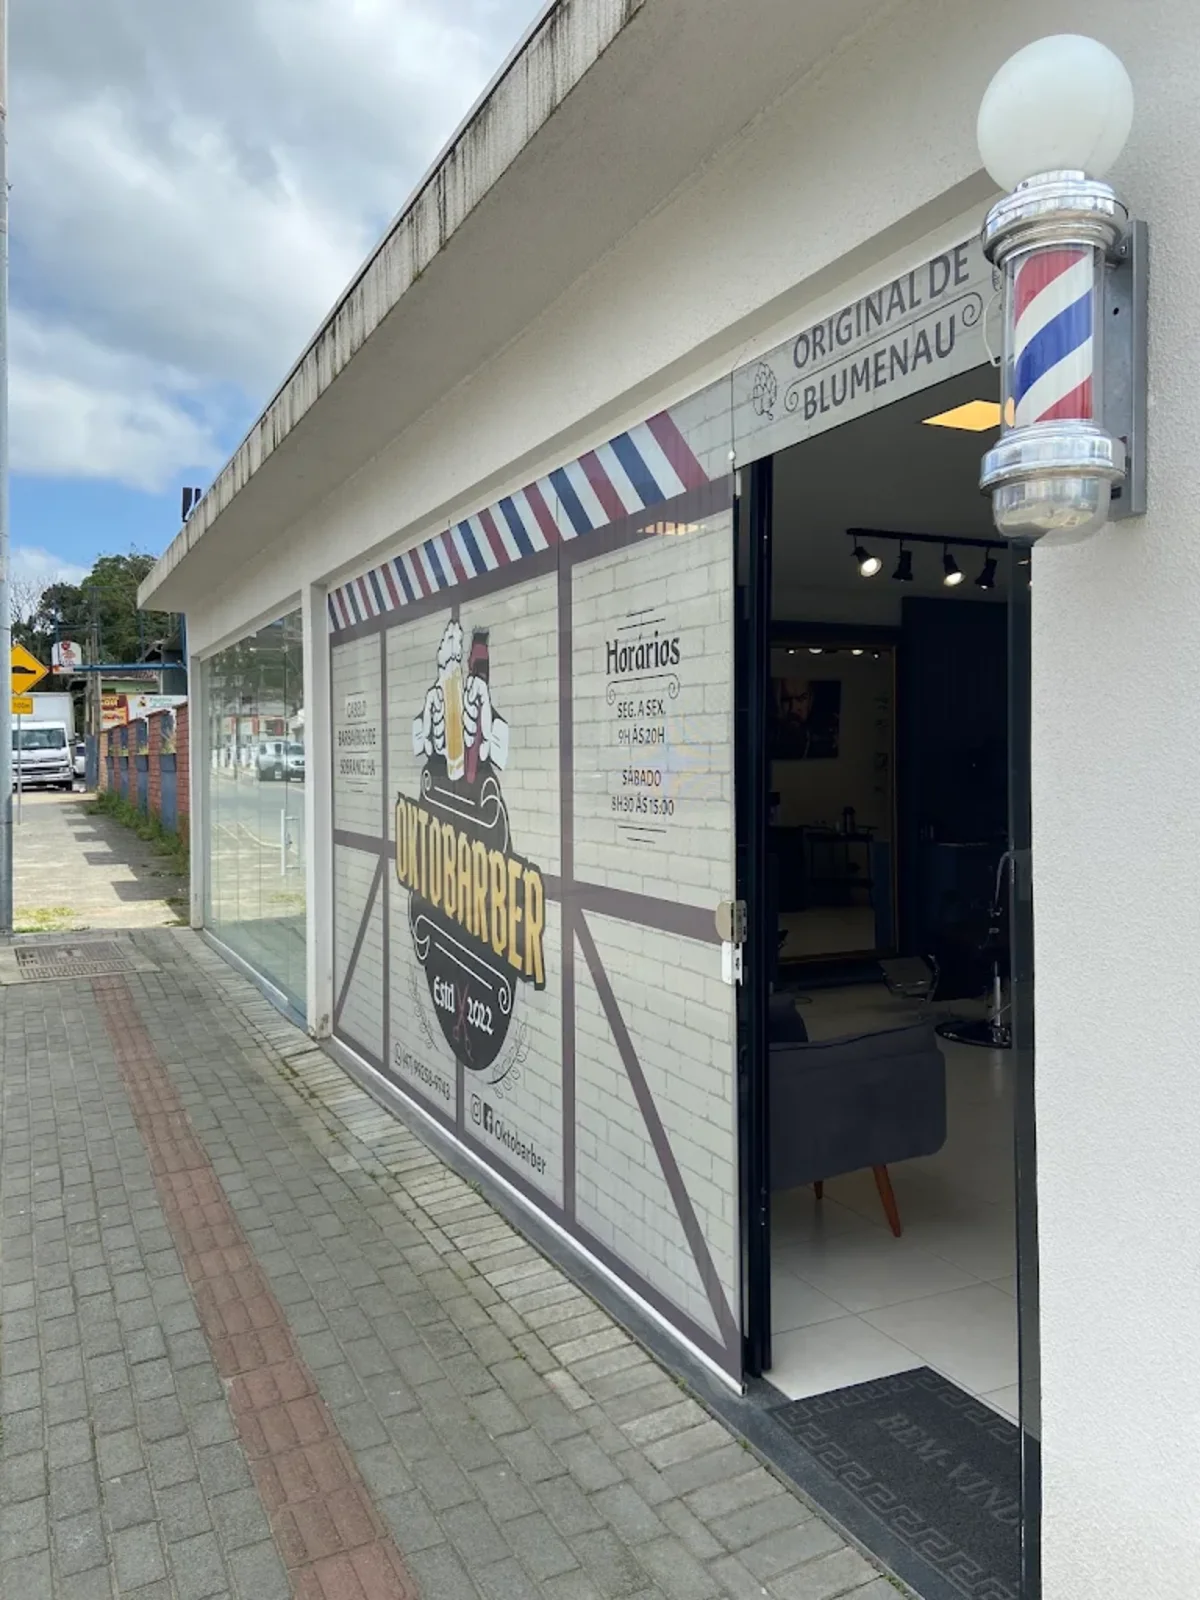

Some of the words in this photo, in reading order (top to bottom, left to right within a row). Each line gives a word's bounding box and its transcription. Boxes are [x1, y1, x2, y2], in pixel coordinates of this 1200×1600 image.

[793, 269, 921, 369] ORIGINAL
[929, 242, 970, 298] DE
[803, 314, 956, 421] BLUMENAU
[606, 630, 680, 675] Horários
[617, 700, 637, 718] SEG.
[638, 700, 645, 717] A
[646, 698, 666, 716] SEX.
[618, 728, 631, 744] 9H
[645, 725, 665, 744] 20H
[622, 765, 662, 787] SÁBADO
[395, 797, 544, 985] OKTOBARBER
[467, 996, 494, 1036] 2022
[494, 1119, 547, 1176] Oktobarber
